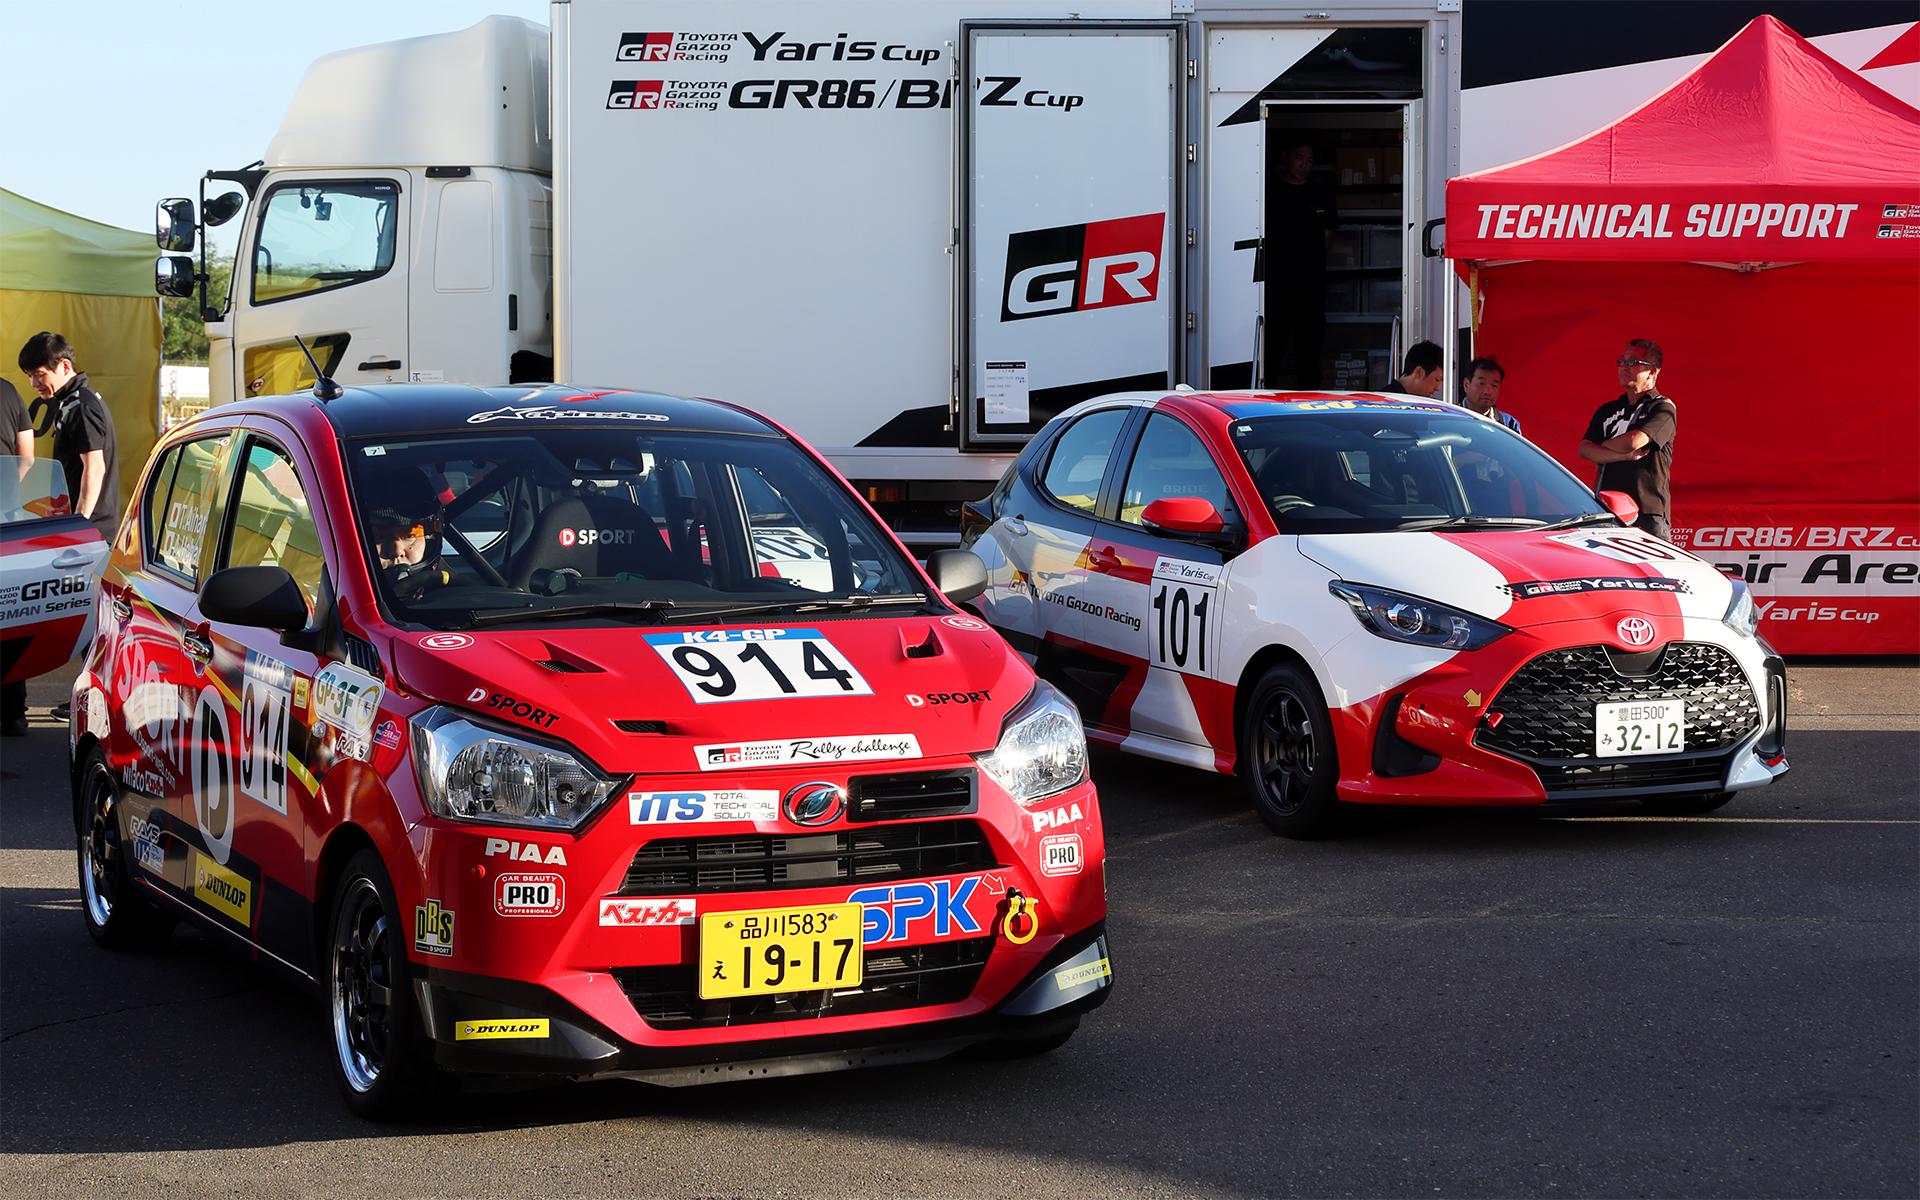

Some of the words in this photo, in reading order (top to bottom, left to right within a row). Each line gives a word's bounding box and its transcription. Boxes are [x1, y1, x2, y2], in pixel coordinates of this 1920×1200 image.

[675, 43, 731, 51] GAZOO
[678, 33, 737, 41] TOYOTA
[617, 40, 671, 61] GR
[674, 52, 728, 63] Racing
[742, 32, 877, 61] Yaris
[881, 45, 940, 66] Cup
[665, 91, 721, 99] GAZOO
[668, 81, 728, 89] TOYOTA
[607, 87, 661, 109] GR
[663, 101, 718, 111] Racing
[1023, 91, 1084, 112] Cup
[1477, 204, 1673, 239] TECHNICAL
[1683, 203, 1858, 238] SUPPORT
[1882, 207, 1908, 218] GR
[1877, 228, 1903, 238] GR
[1006, 239, 1158, 317] GR
[578, 529, 635, 545] SPORT
[1693, 526, 1895, 547] GR86/BRZ
[1181, 565, 1204, 579] Yaris
[1801, 554, 1920, 584] Are
[1581, 579, 1647, 589] Yaris
[1649, 582, 1676, 591] Cup
[45, 597, 91, 613] Series
[1008, 575, 1028, 595] GR
[1030, 584, 1064, 606] TOYOTA
[1066, 595, 1103, 617] GAZOO
[1104, 606, 1141, 632] Racing
[1840, 609, 1880, 624] Cup
[682, 629, 786, 644] K4-GP
[1153, 585, 1209, 672] 101
[672, 641, 854, 697] 914
[117, 627, 189, 776] SPORT
[316, 671, 360, 719] GP-3F
[926, 690, 992, 705] SPORT
[486, 693, 560, 729] SPORT
[242, 682, 287, 807] 914
[336, 733, 370, 760] RAYS
[851, 739, 911, 755] challenge
[1601, 734, 1613, 746] み
[1616, 723, 1679, 752] 32-12
[709, 750, 741, 764] GR
[713, 812, 776, 820] SOLUTIONS
[1032, 803, 1084, 833] PIAA
[485, 837, 568, 866] PIAA
[1049, 846, 1075, 865] PRO
[205, 872, 247, 909] DUNLOP
[508, 885, 550, 905] PRO
[601, 900, 695, 924] ベストカー
[847, 876, 982, 945] SPK
[418, 901, 452, 944] DRS
[712, 961, 727, 979] え
[743, 938, 854, 988] 19-17
[1071, 964, 1107, 981] DUNLOP
[475, 1025, 540, 1034] DUNLOP
